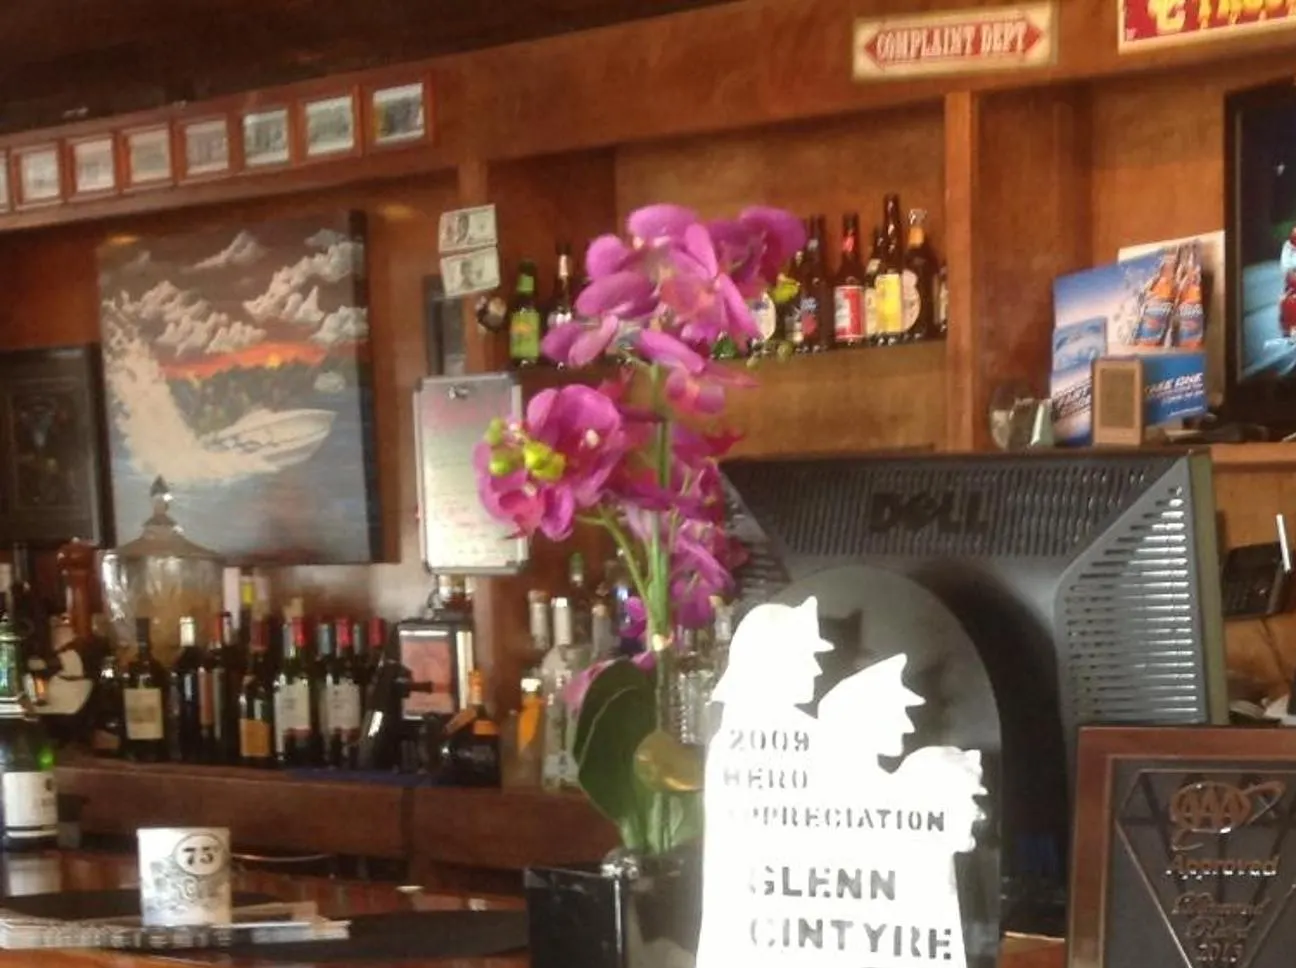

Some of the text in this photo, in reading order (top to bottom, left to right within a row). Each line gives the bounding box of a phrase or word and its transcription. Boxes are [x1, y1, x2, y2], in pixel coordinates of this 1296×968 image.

[876, 25, 976, 62] COMPLAINT
[872, 491, 988, 533] DELL
[729, 730, 810, 752] 2009
[723, 768, 808, 790] HERO
[748, 806, 945, 832] PPRECIATION
[750, 865, 896, 901] GLENN
